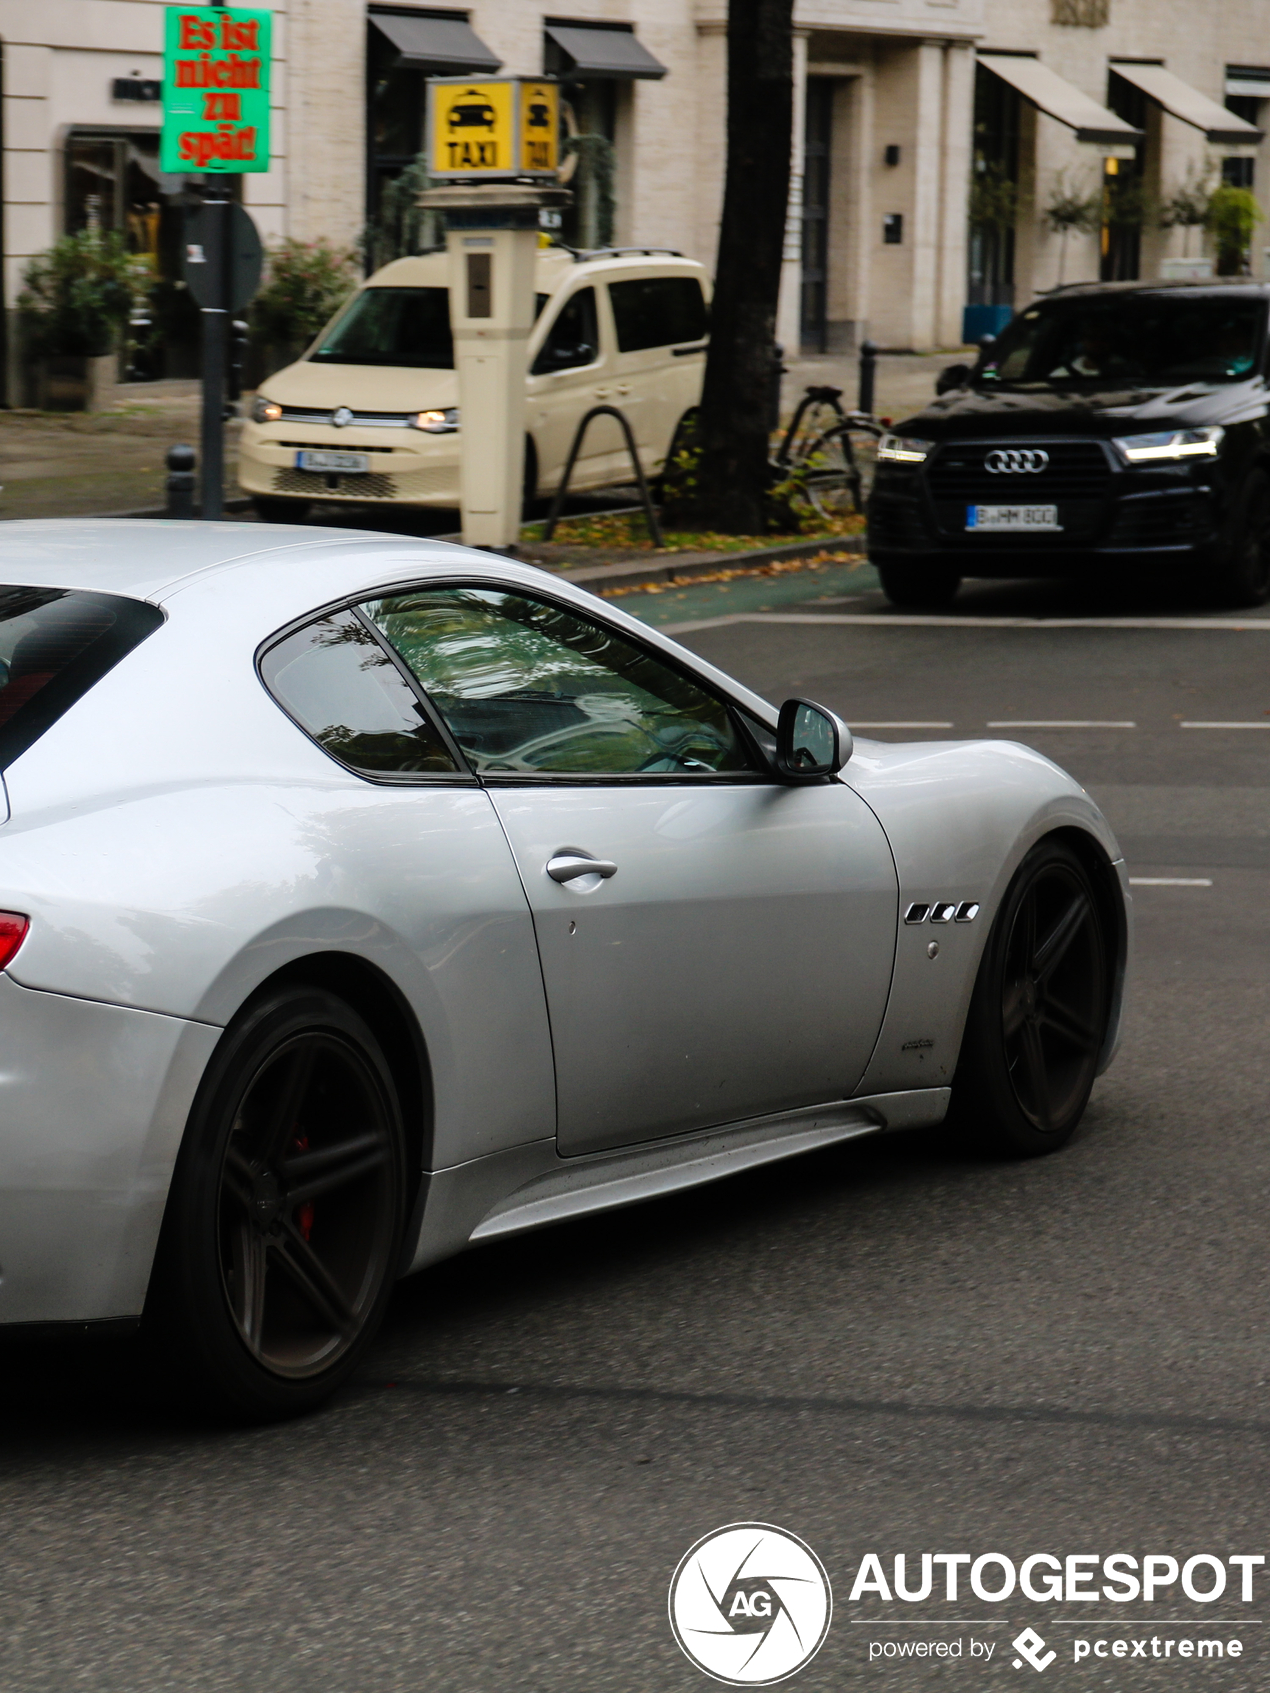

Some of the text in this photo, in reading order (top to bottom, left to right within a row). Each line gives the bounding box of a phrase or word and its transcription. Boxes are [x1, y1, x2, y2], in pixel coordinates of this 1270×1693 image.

[178, 14, 260, 51] Es ist
[174, 52, 262, 89] nicht
[201, 92, 243, 121] zu
[177, 123, 257, 167] spät!
[446, 141, 497, 168] TAXI
